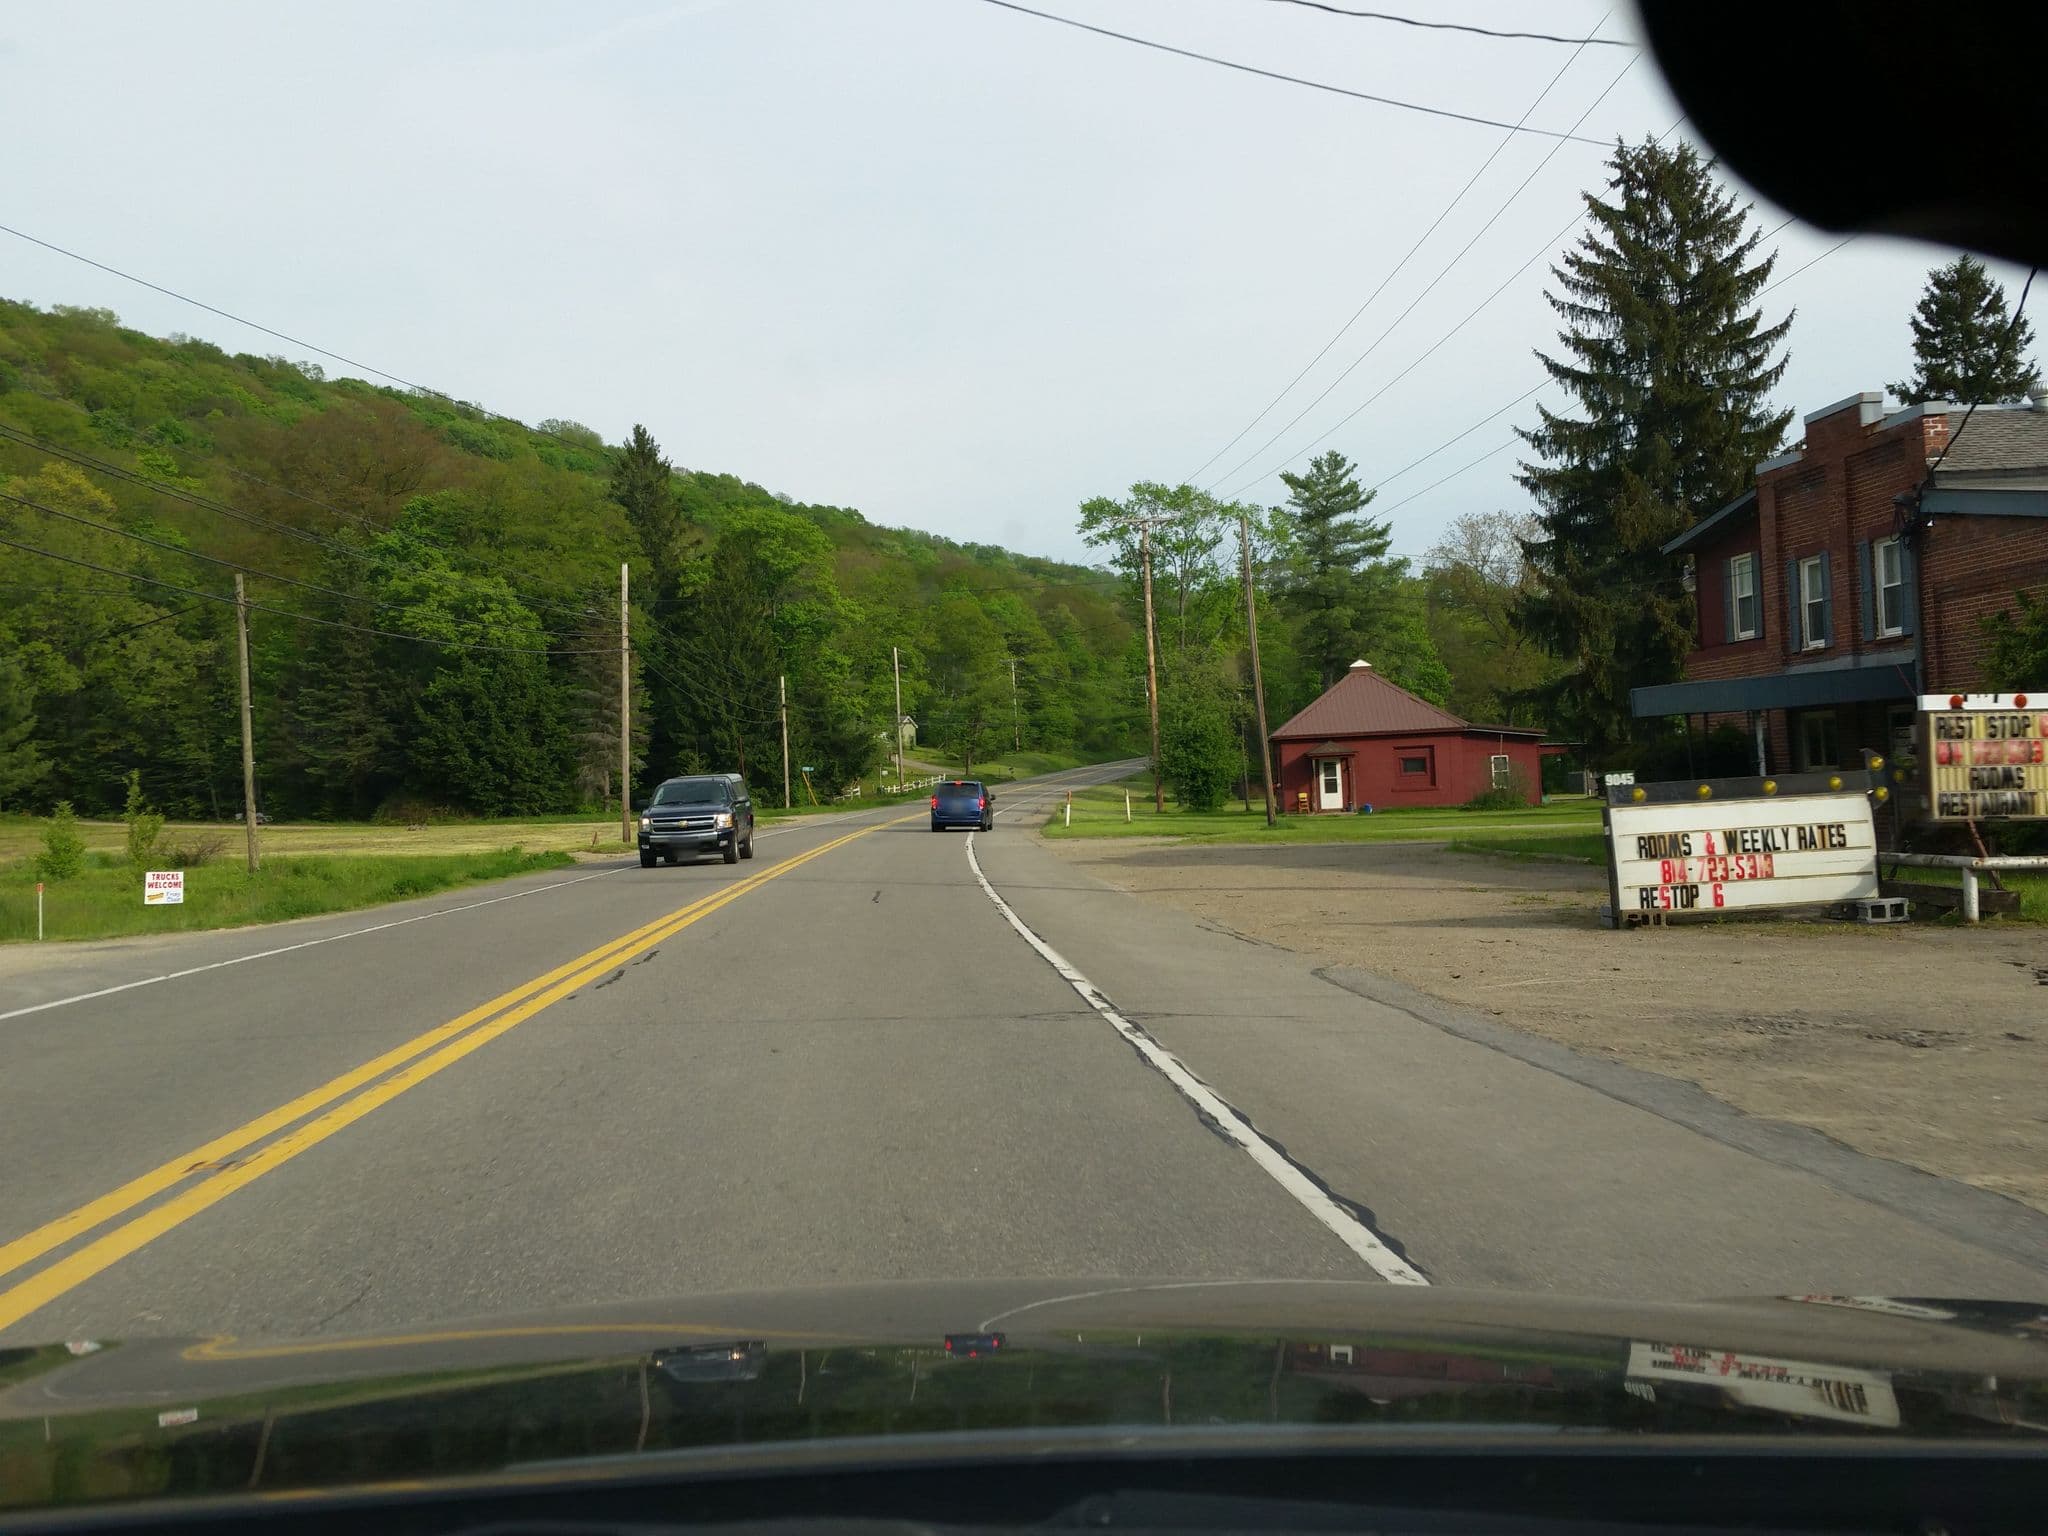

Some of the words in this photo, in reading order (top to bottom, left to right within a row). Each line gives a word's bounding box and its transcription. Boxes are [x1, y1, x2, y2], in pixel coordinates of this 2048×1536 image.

[1988, 715, 2031, 739] STOP
[1605, 773, 1635, 786] 9045
[1638, 832, 1692, 858] ROOMS
[1705, 831, 1716, 855] &
[1722, 826, 1791, 855] WEEKLY
[1798, 823, 1847, 849] RATES
[152, 873, 179, 881] TRUCKS
[1660, 854, 1775, 883] 814-723-5313
[147, 881, 182, 889] WELCOME
[1639, 884, 1699, 909] RESTOP
[1712, 883, 1725, 908] 6
